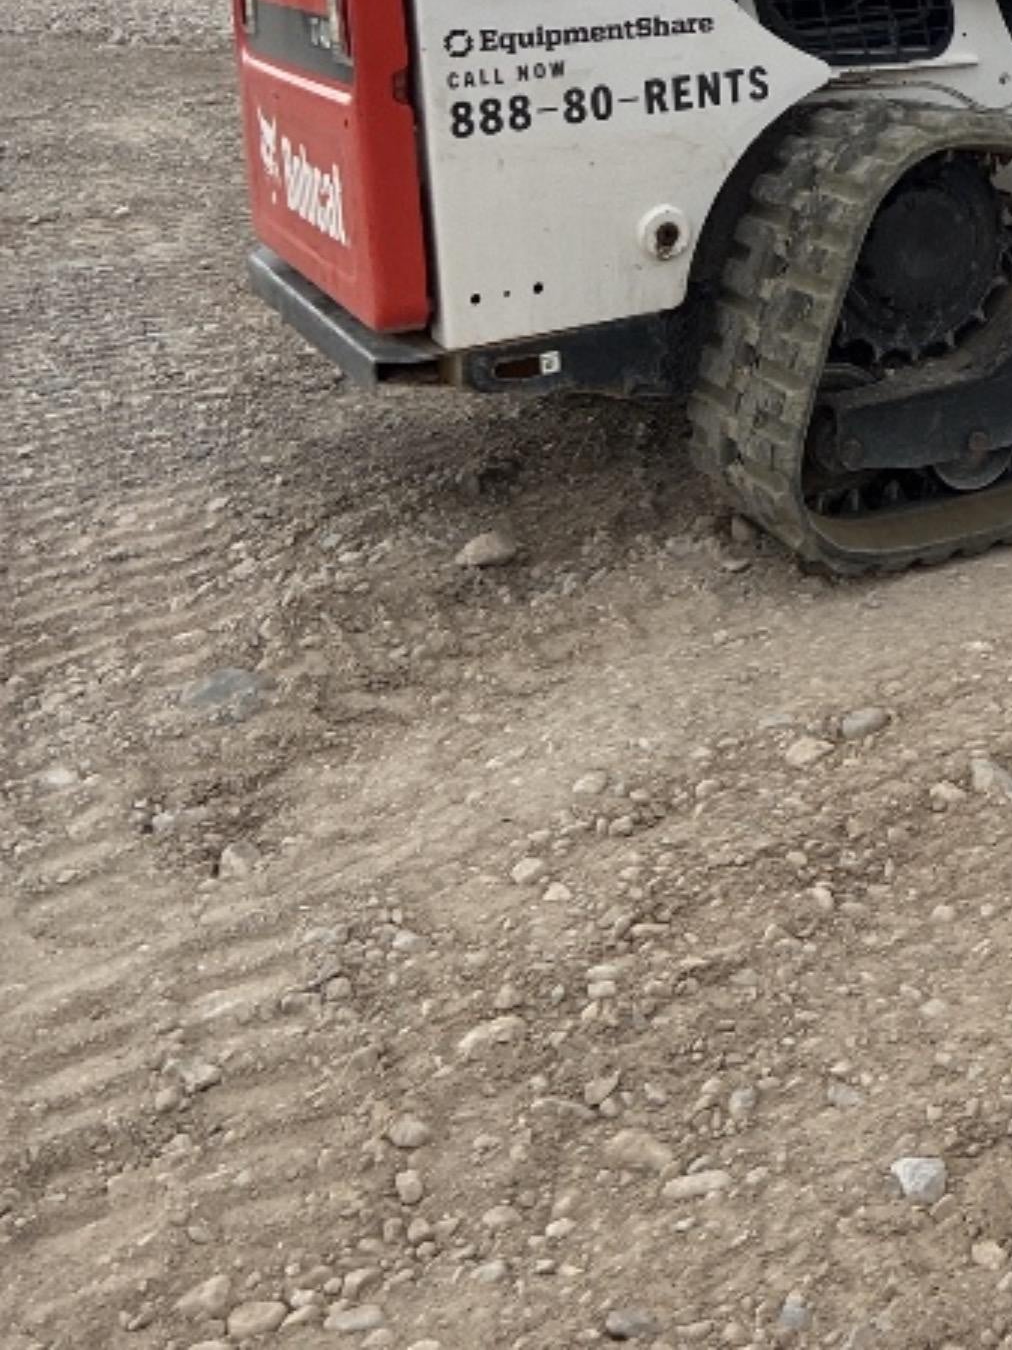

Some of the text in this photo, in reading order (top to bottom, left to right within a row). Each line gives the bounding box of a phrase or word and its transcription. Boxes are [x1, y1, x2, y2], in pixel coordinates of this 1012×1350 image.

[479, 16, 714, 54] EquipmentShare
[447, 60, 566, 89] CALL NOW
[450, 66, 769, 138] 888-80-RENTS
[281, 134, 346, 246] Bobcat
